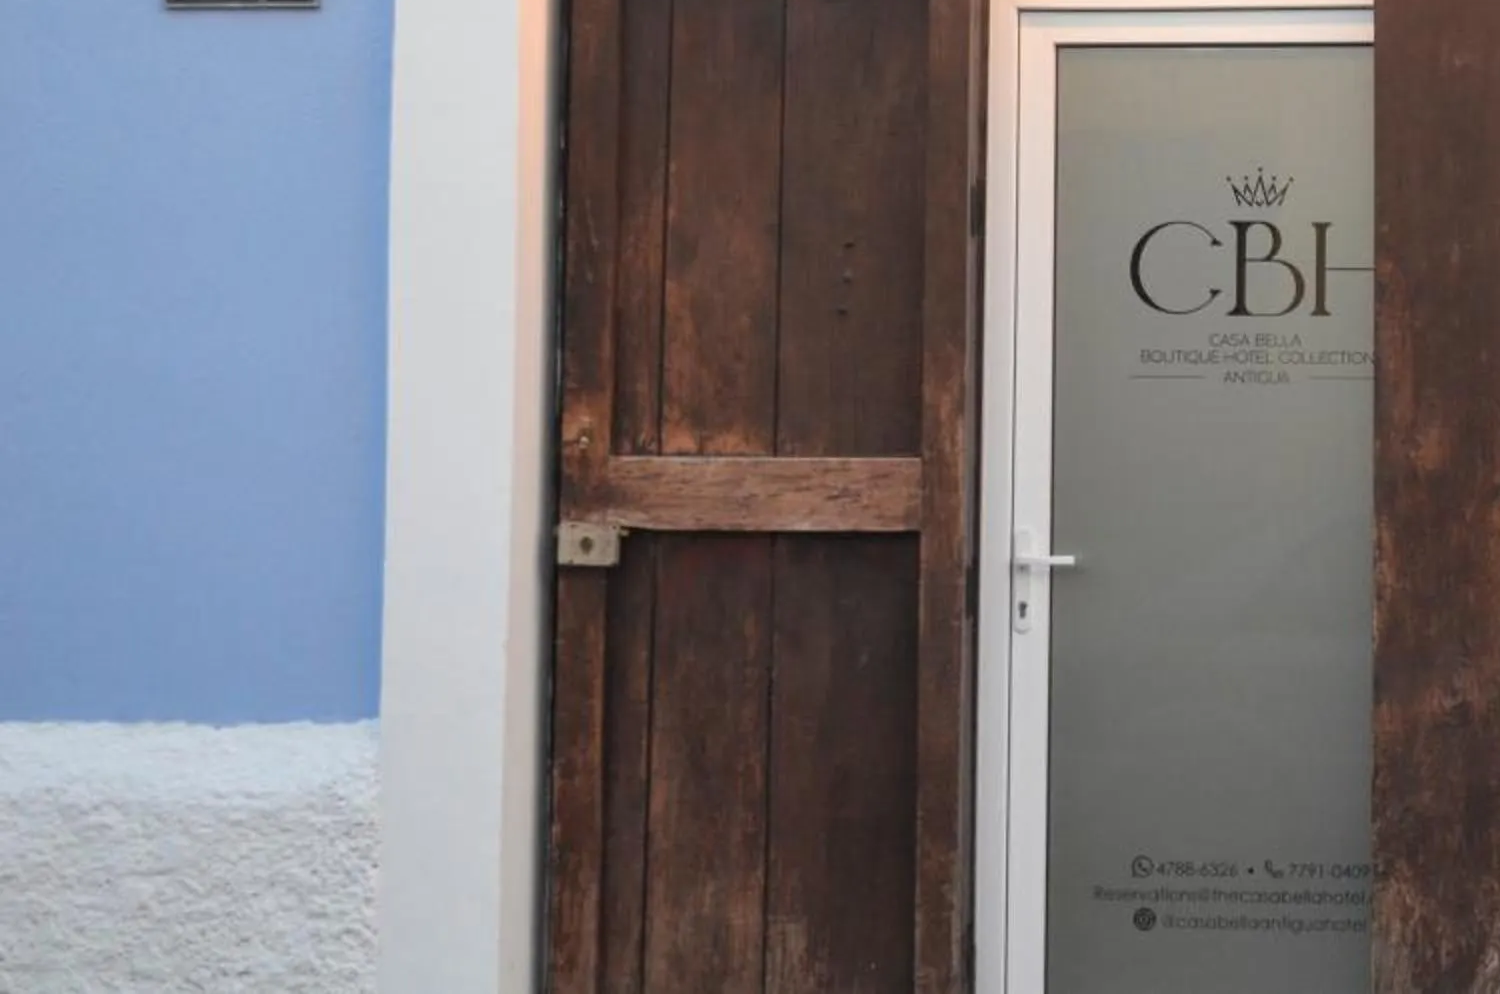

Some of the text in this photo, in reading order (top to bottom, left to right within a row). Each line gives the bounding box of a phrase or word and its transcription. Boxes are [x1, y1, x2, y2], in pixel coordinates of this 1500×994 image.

[1208, 332, 1302, 348] CASA BELLA
[1140, 349, 1374, 366] BOUTIQUE HOTEL COLLECTION
[1223, 370, 1290, 385] ANTIGUA
